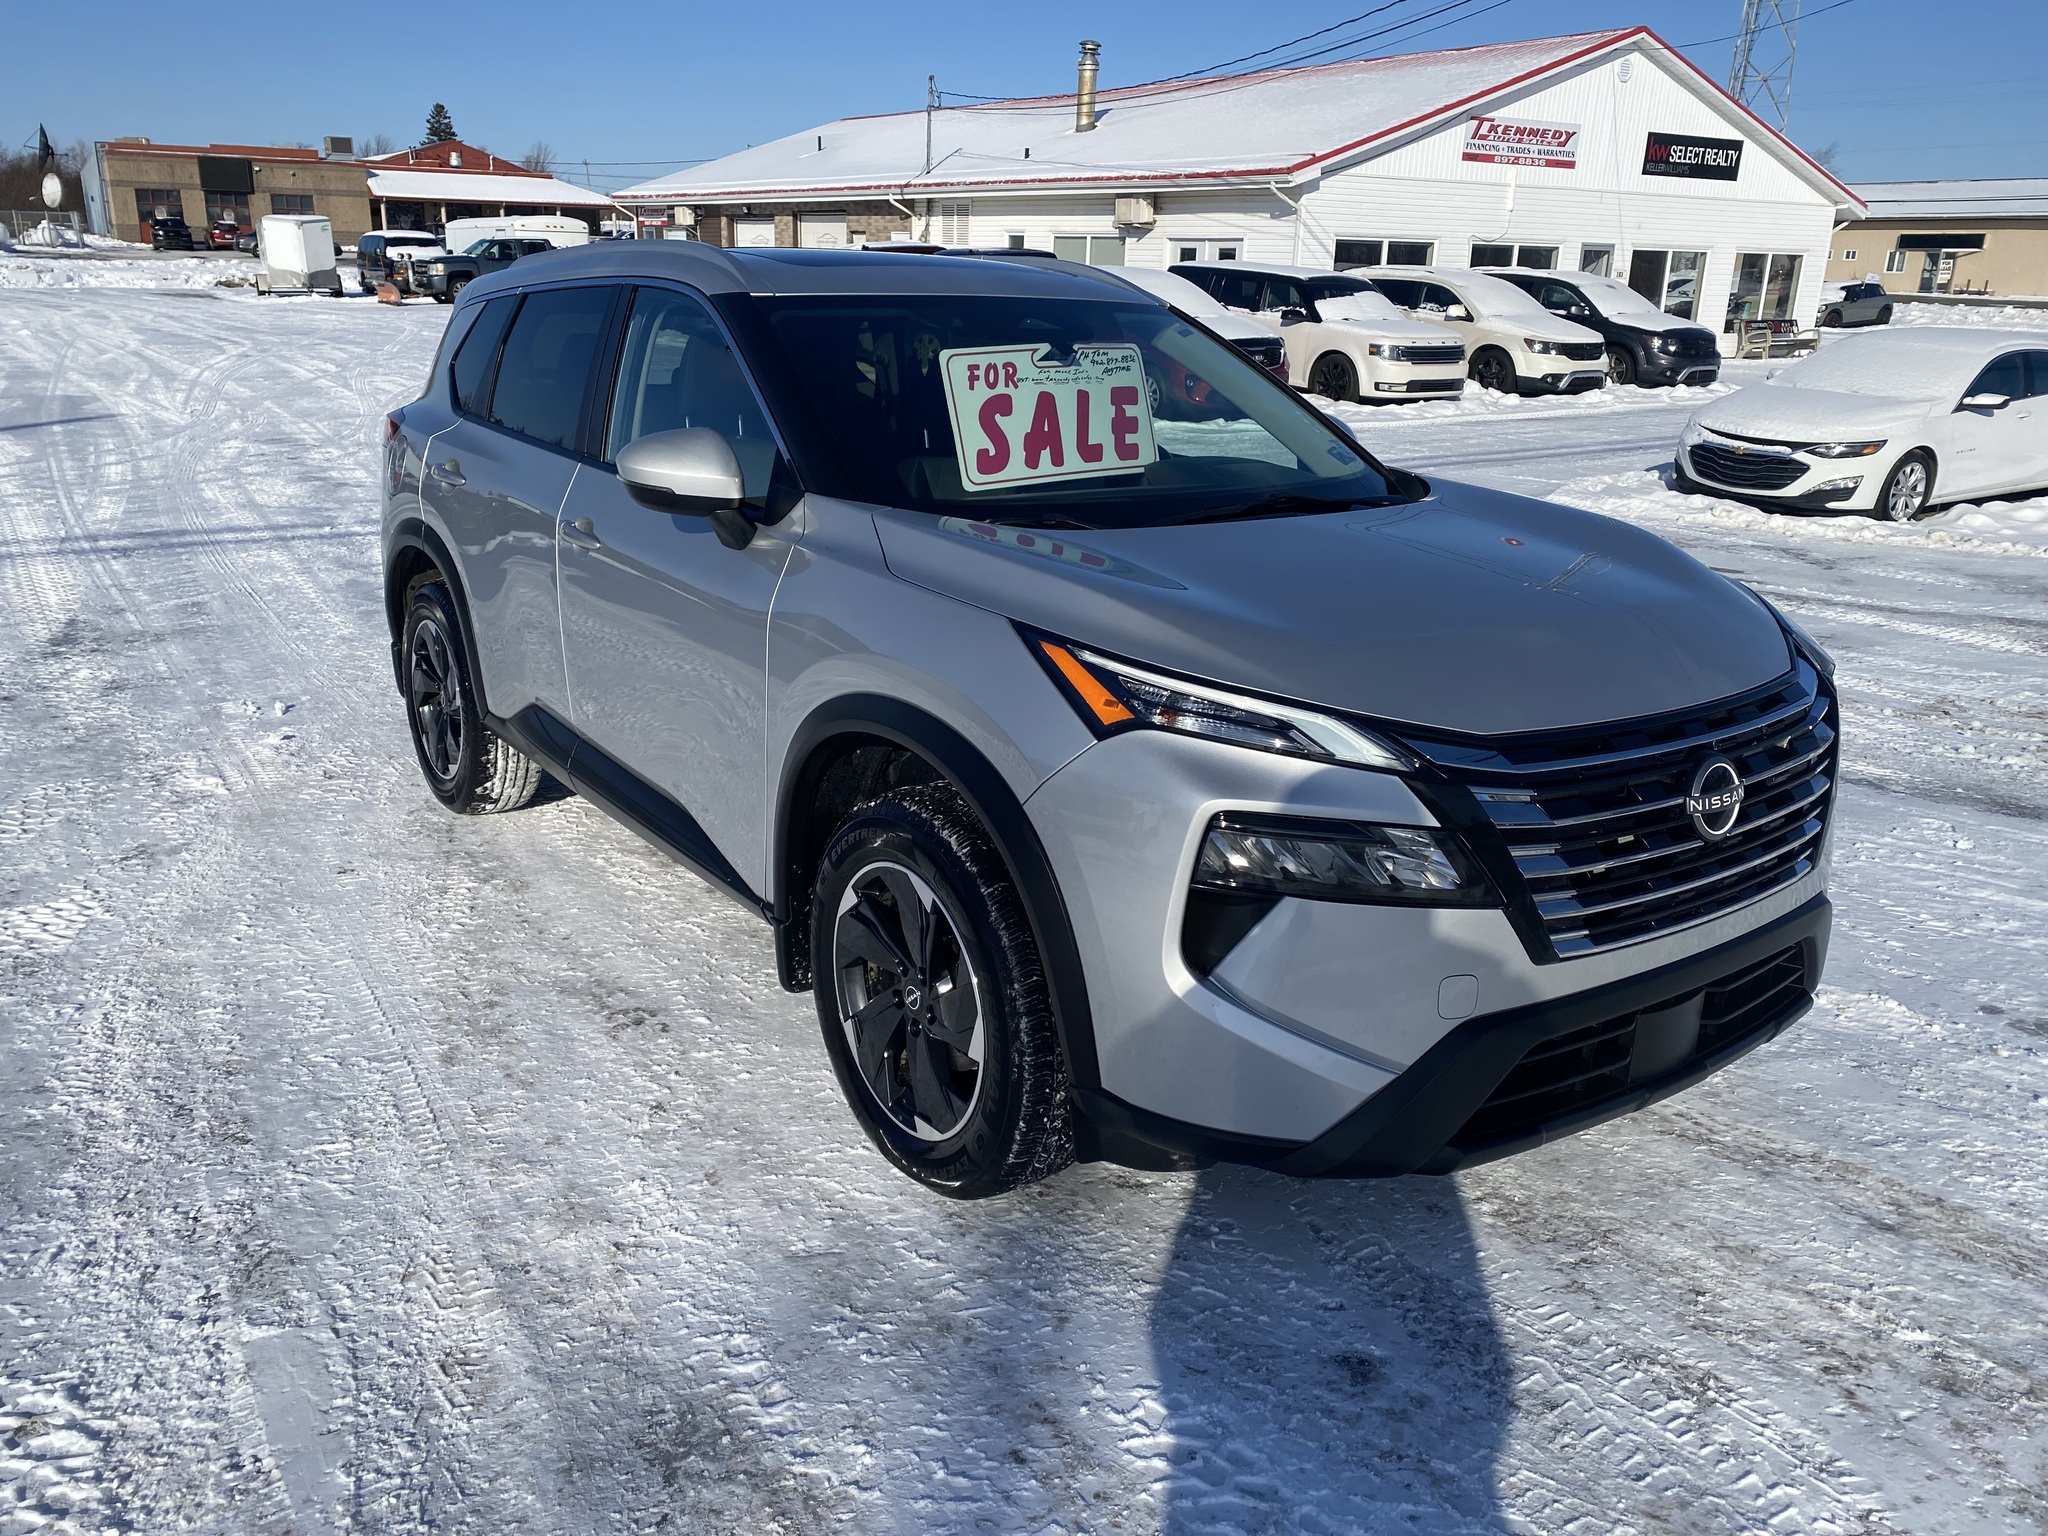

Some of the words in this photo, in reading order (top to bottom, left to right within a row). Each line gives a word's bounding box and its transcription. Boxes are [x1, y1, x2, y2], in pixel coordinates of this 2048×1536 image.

[1466, 142, 1500, 152] FINANCING
[1507, 146, 1531, 155] TRADES
[1537, 148, 1575, 158] WARRANTIES
[1487, 135, 1519, 143] AUTO
[1494, 155, 1546, 166] 897-8836
[1669, 145, 1705, 165] SELECT
[1704, 148, 1739, 167] REALTY
[967, 361, 1020, 391] FOR
[976, 385, 1140, 475] SALE
[1690, 785, 1744, 811] NISSAN
